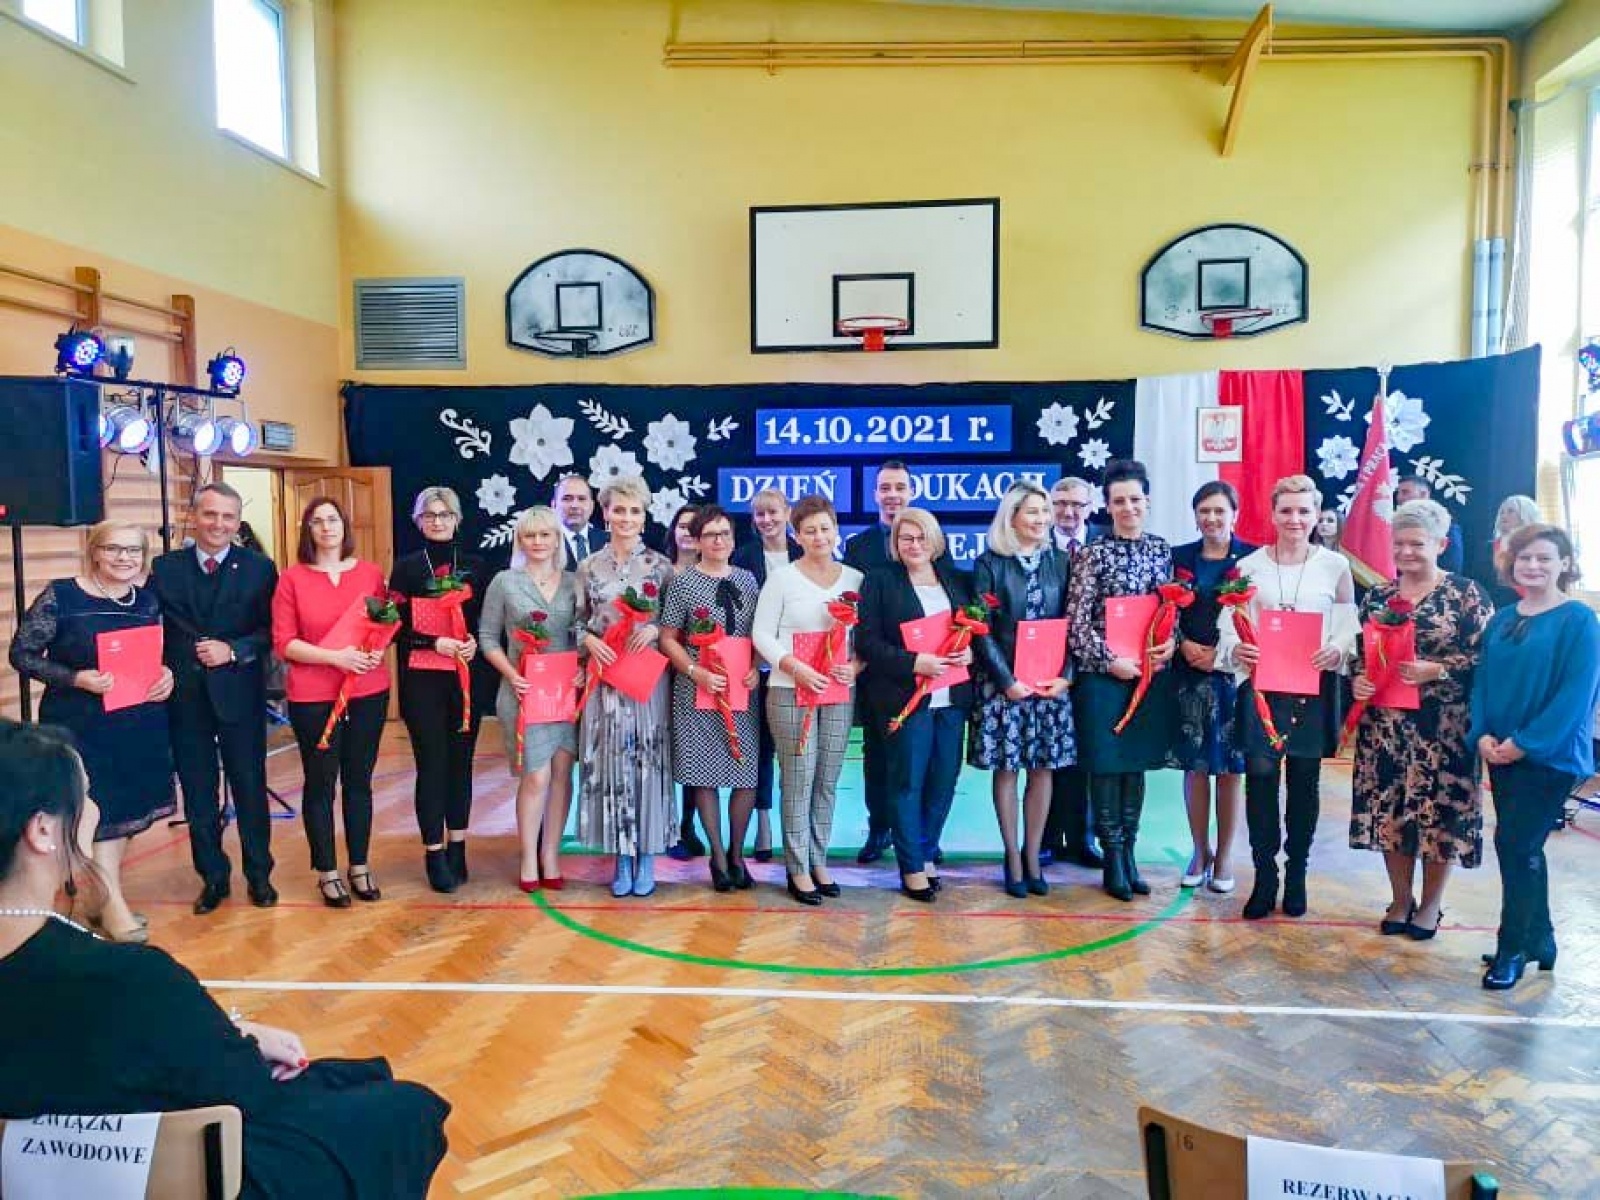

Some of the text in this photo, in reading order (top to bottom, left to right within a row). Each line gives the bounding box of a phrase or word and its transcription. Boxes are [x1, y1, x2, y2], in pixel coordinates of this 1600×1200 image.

[763, 414, 994, 445] 14.10.2021 r.
[731, 469, 1047, 503] DZIEŃ DUKACI
[20, 1137, 147, 1164] ZAWODOWE
[1281, 1178, 1420, 1200] REZERW
